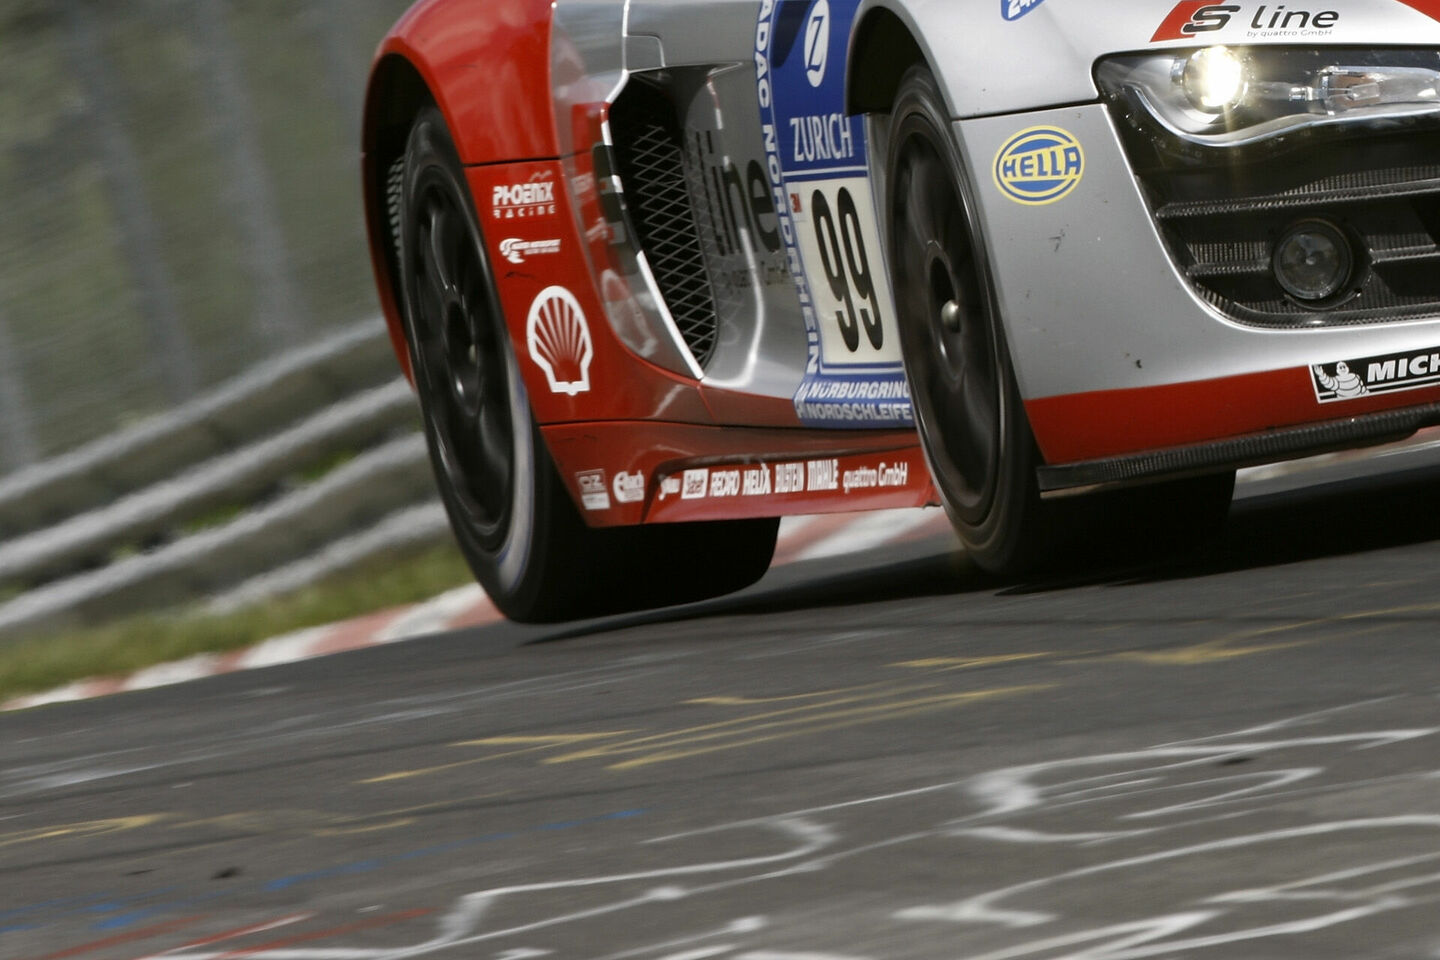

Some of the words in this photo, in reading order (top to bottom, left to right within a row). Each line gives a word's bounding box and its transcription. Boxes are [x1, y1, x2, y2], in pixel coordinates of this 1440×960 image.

[1251, 5, 1340, 29] line
[789, 112, 854, 162] ZURICH
[1003, 146, 1082, 177] HELLA
[812, 186, 884, 353] 99
[804, 403, 913, 420] NORDSCHLEIFE
[843, 466, 877, 494] quattro
[878, 462, 908, 487] GmbH
